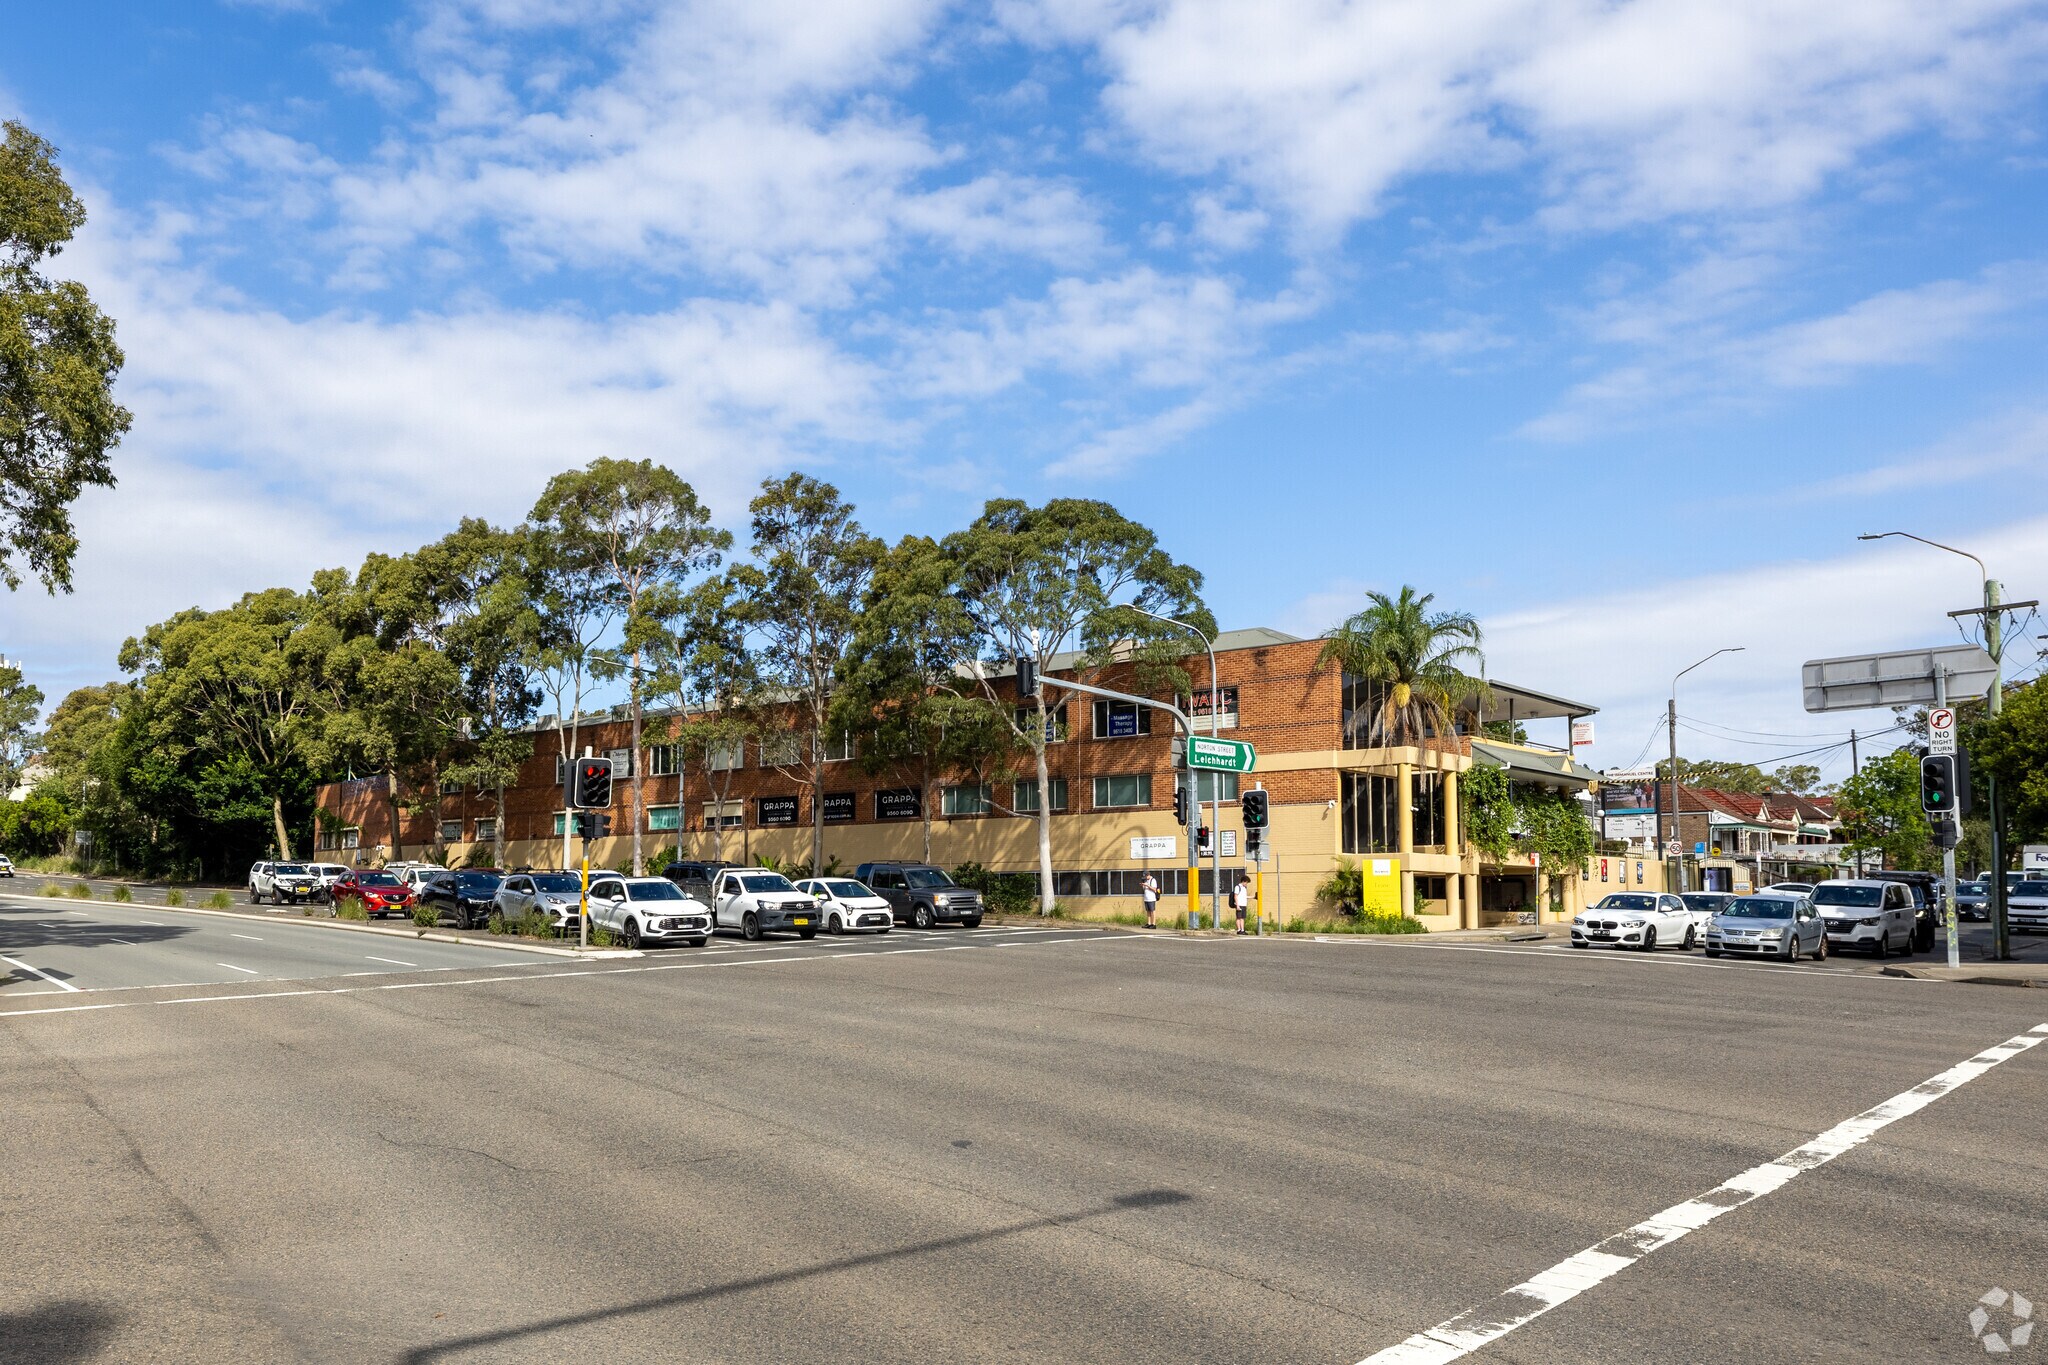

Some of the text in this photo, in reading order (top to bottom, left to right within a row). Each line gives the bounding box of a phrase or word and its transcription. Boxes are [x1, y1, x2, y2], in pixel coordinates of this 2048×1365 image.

[1194, 754, 1236, 767] Leichhardt
[882, 795, 916, 803] GRAPPA
[764, 802, 794, 810] GRAPPA
